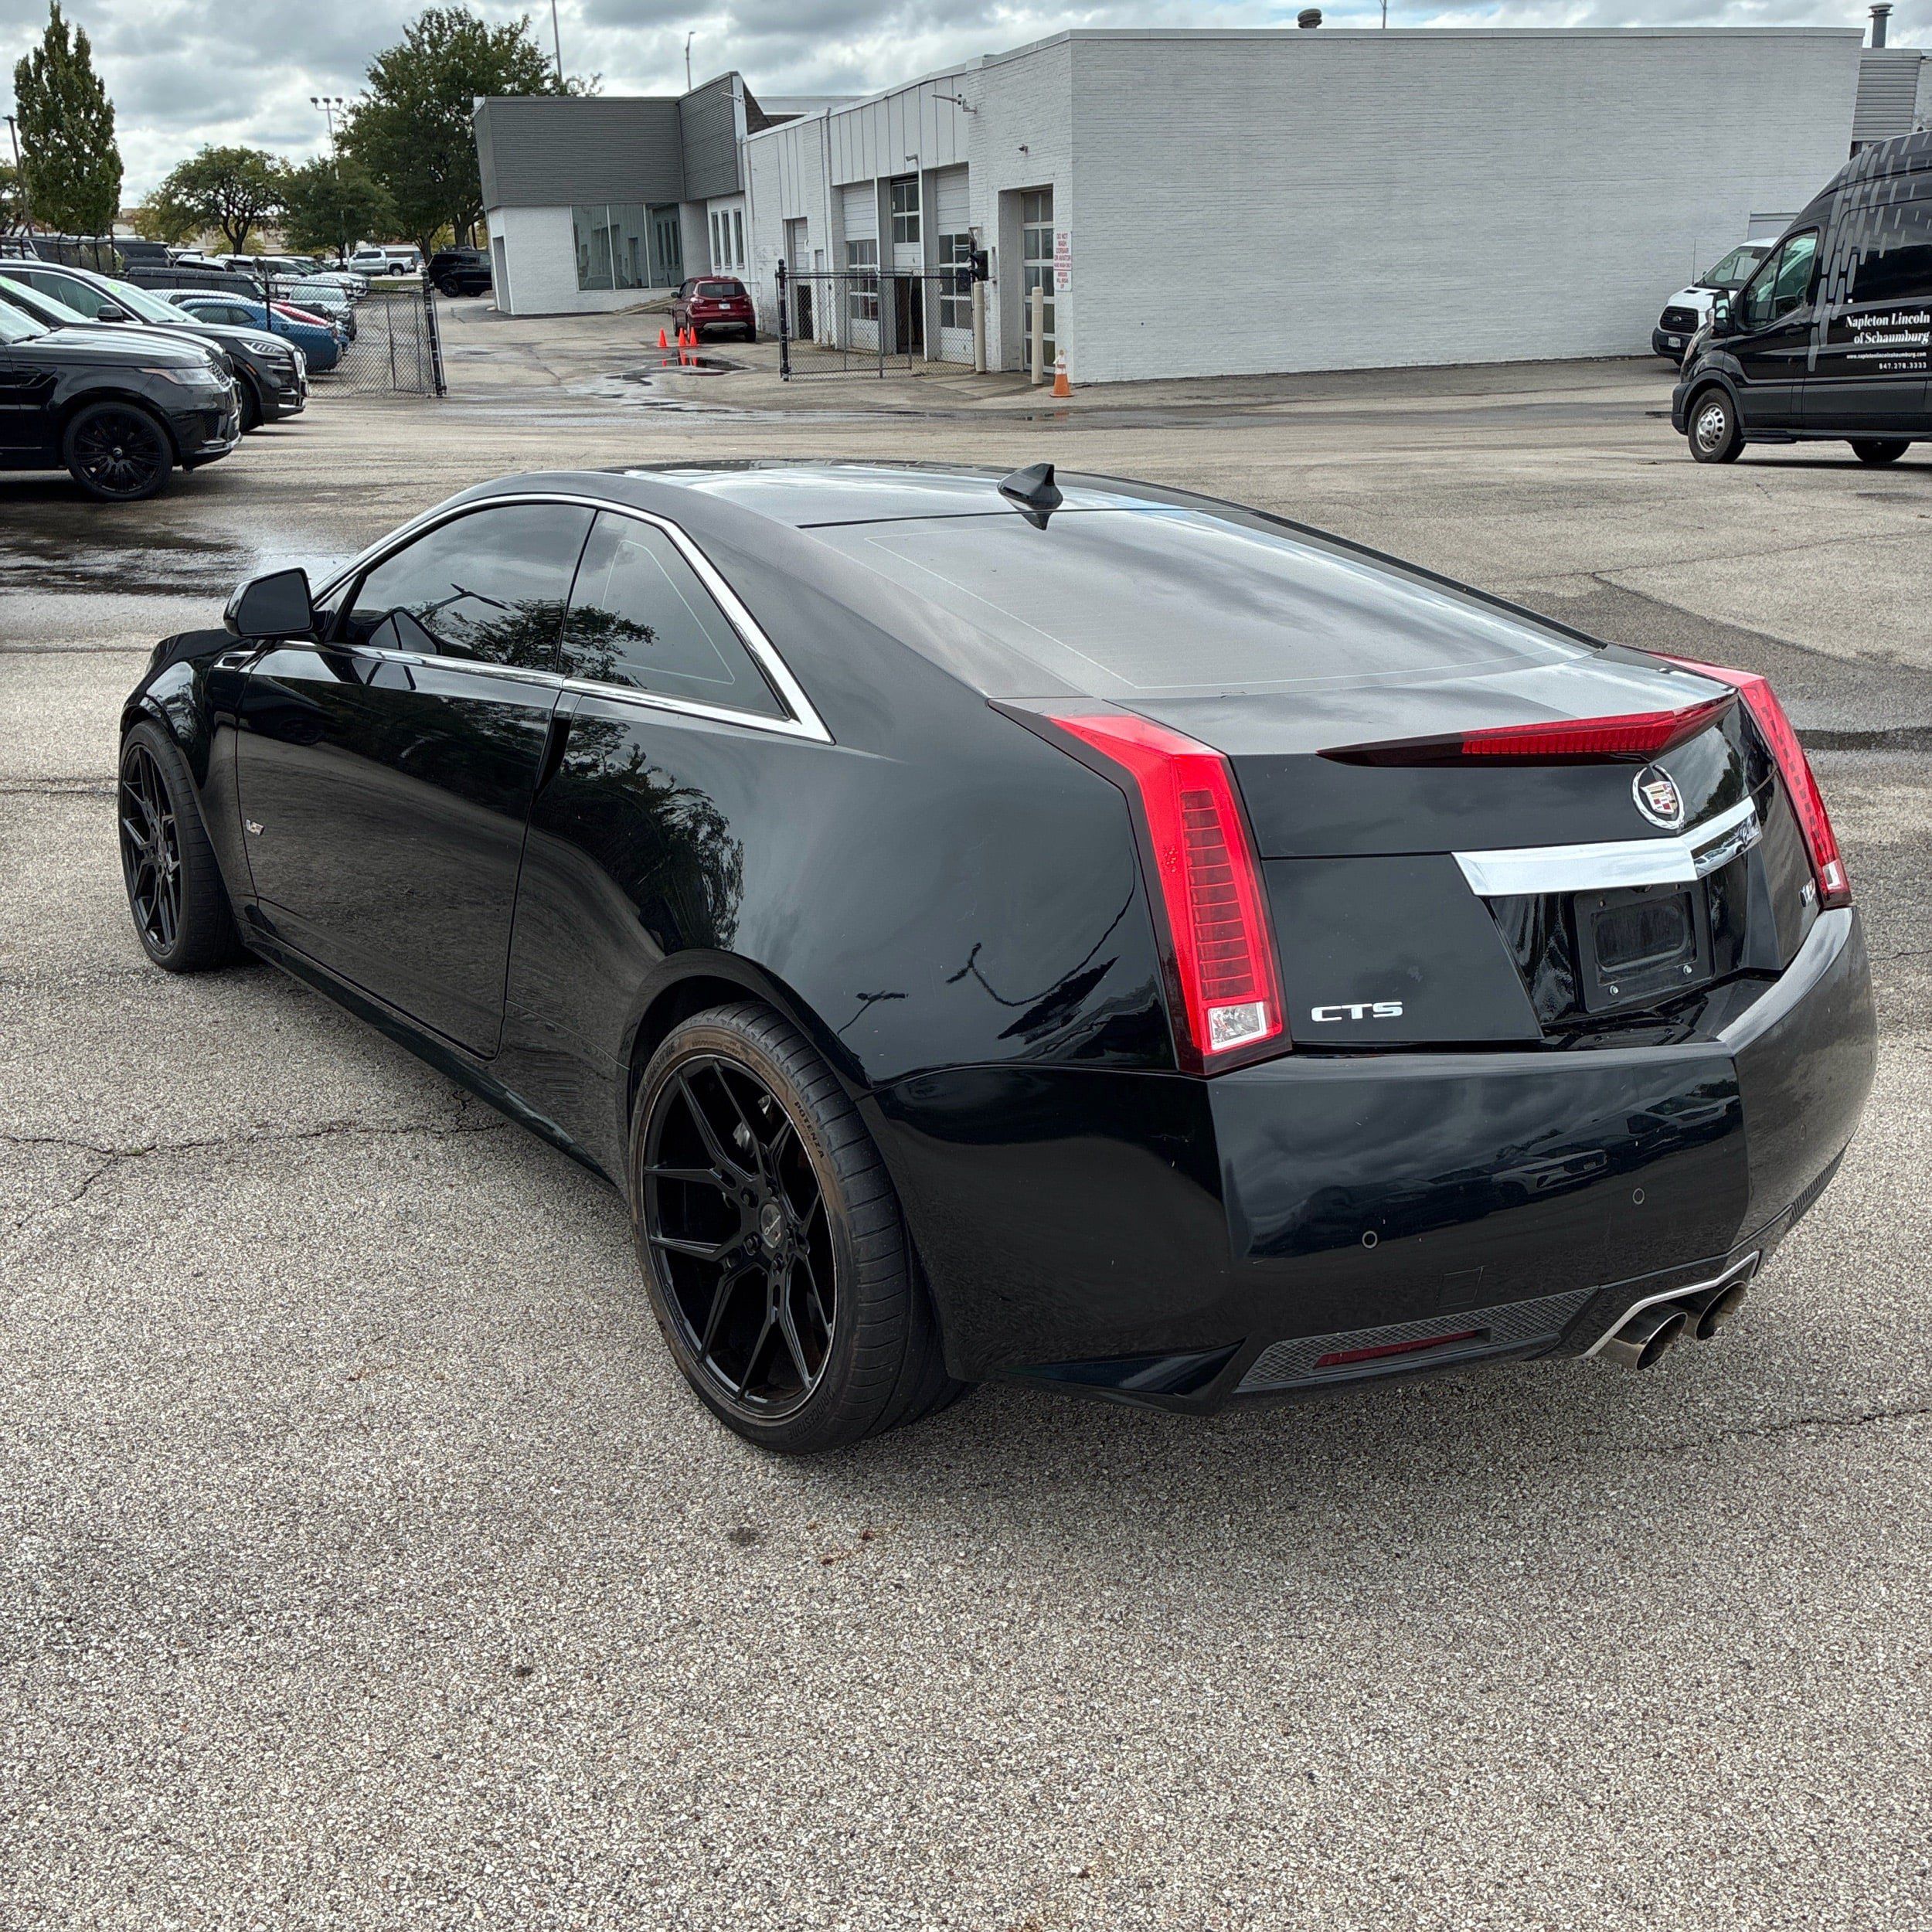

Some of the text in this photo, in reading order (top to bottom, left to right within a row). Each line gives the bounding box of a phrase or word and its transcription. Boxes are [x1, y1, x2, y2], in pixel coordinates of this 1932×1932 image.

[1845, 311, 1930, 330] Napleton Lincoln
[1854, 329, 1930, 345] of Schaumburg
[1311, 1001, 1403, 1022] CTS
[794, 1101, 825, 1158] POTENZA
[787, 1383, 835, 1440] BRIDGESTONE
